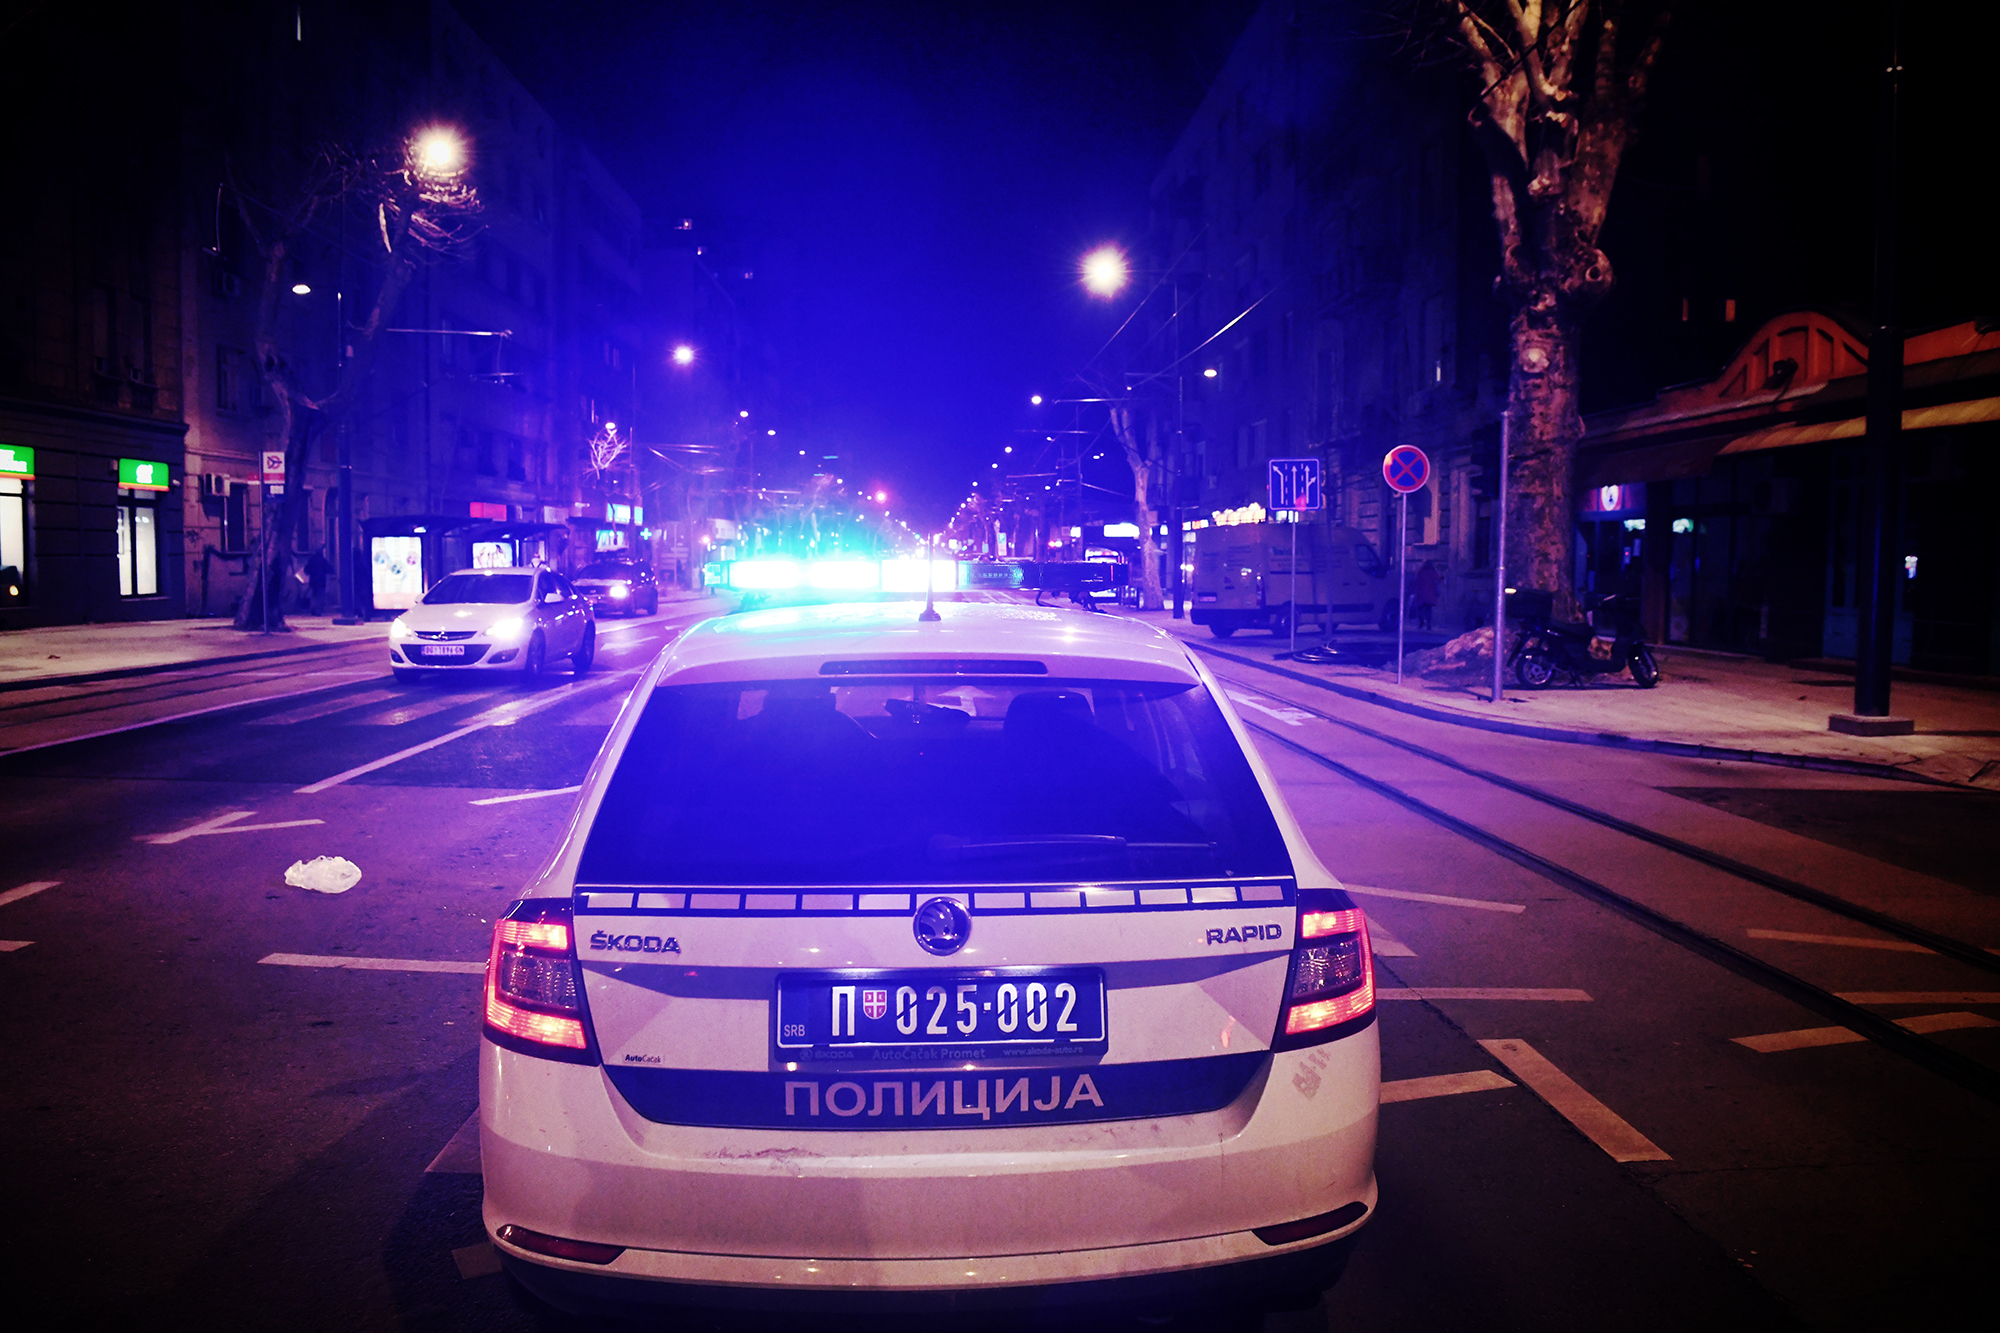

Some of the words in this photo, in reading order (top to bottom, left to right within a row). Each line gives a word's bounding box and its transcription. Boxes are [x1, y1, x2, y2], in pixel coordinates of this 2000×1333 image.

[590, 930, 681, 954] ŠKODA
[1206, 924, 1282, 946] RAPID
[831, 985, 856, 1037] П
[783, 1024, 806, 1038] SRB
[941, 1048, 986, 1060] Promet
[784, 1073, 1105, 1120] ПОЛИЦИЈА
